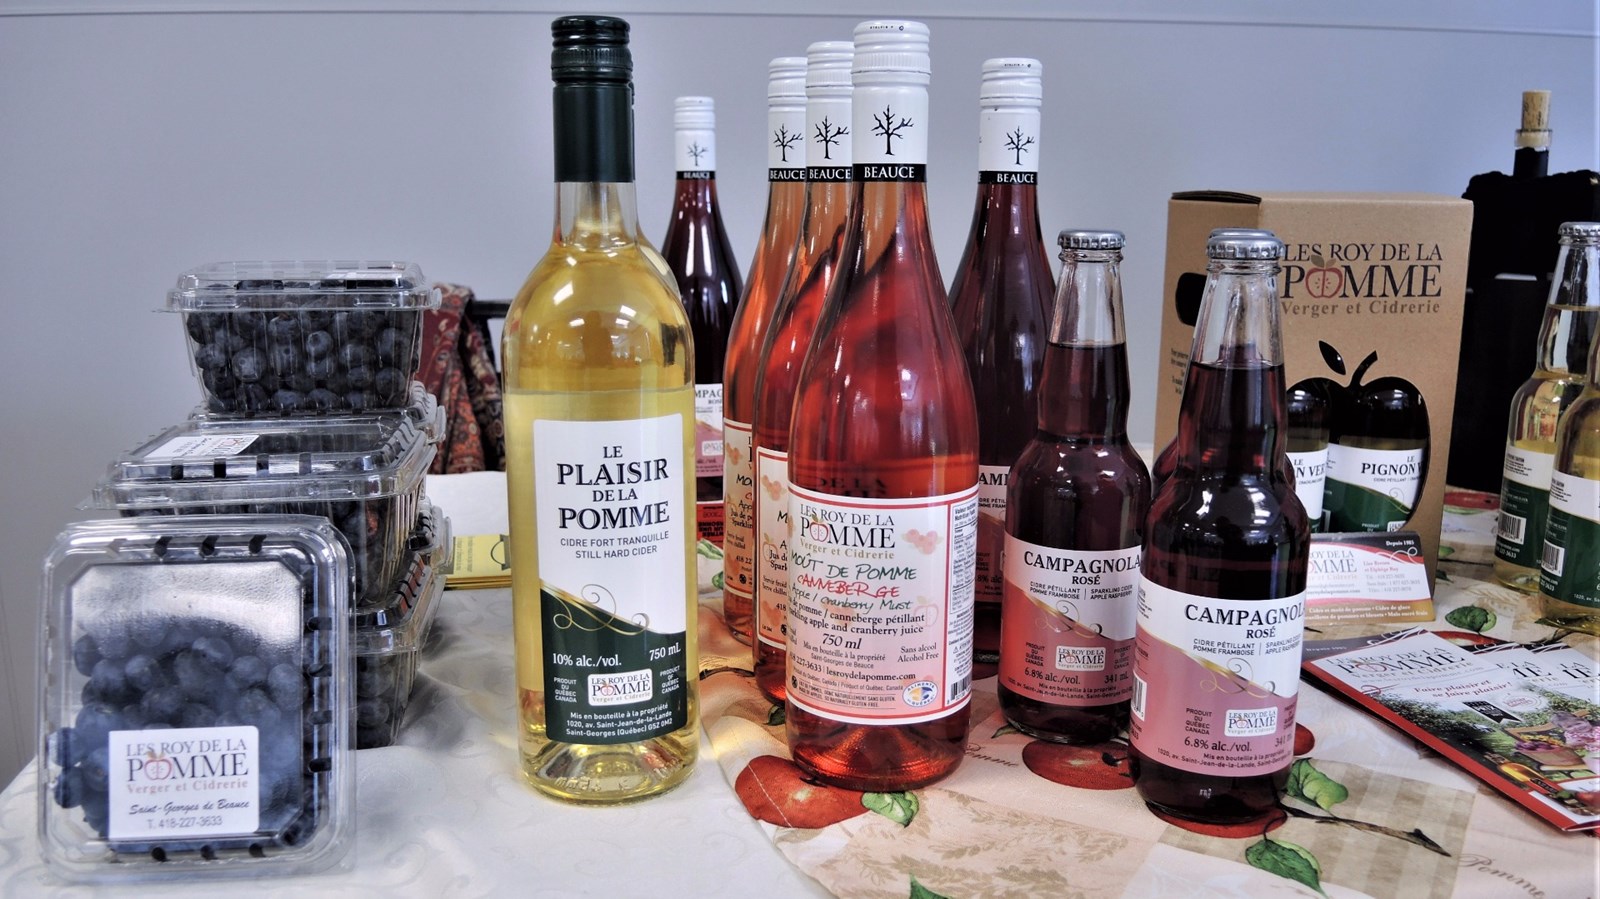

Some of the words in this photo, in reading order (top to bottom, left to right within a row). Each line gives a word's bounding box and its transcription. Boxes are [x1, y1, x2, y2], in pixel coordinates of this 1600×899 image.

[770, 170, 805, 179] BEAUCE
[809, 169, 850, 179] BEAUCE
[864, 166, 915, 178] BEAUCE
[997, 174, 1034, 183] BEAUCE
[1283, 243, 1322, 262] LES
[1330, 244, 1373, 262] ROY
[1380, 244, 1410, 261] DE
[1416, 243, 1443, 260] LA
[1280, 264, 1441, 299] POMME
[1281, 302, 1339, 317] Verger
[1347, 304, 1362, 314] et
[1369, 300, 1440, 314] Cidrerie
[603, 446, 623, 458] LE
[557, 458, 668, 485] PLAISIR
[1361, 462, 1416, 475] PIGNON
[592, 490, 614, 502] DE
[618, 488, 638, 500] LA
[559, 501, 669, 530] POMME
[801, 504, 818, 516] LES
[821, 510, 847, 523] ROY
[852, 514, 871, 525] DE
[876, 515, 894, 526] LA
[560, 538, 587, 547] CIDRE
[591, 538, 614, 547] FORT
[617, 531, 669, 545] TRANQUILLE
[801, 516, 895, 549] POMME
[604, 547, 629, 558] HARD
[632, 545, 657, 556] CIDER
[801, 538, 827, 556] Verger
[832, 546, 840, 555] et
[844, 549, 894, 559] Cidrerie
[792, 551, 823, 571] MOÛT
[826, 565, 849, 578] DE
[856, 563, 917, 580] POMME
[1024, 551, 1141, 574] CAMPAGNOLA
[1030, 581, 1046, 589] CIDRE
[1048, 584, 1080, 593] PÉTILLANT
[1072, 575, 1100, 585] ROSÉ
[792, 583, 810, 600] Apple
[820, 596, 873, 614] Cranberry
[880, 599, 911, 610] Must
[1030, 587, 1047, 596] POMME
[1049, 590, 1080, 599] FRAMBOISE
[800, 603, 822, 616] pomme
[830, 612, 882, 625] canneberge
[886, 614, 924, 625] pétillant
[1185, 603, 1305, 626] CAMPAGNOL
[810, 618, 828, 628] apple
[832, 623, 847, 632] and
[850, 625, 898, 636] cranberry
[900, 626, 923, 636] juice
[1246, 626, 1275, 639] ROSÉ
[823, 633, 842, 646] 750
[845, 638, 862, 649] ml
[918, 642, 936, 652] alcool
[1194, 639, 1215, 647] CIDRE
[1218, 641, 1255, 649] PÉTILLANT
[649, 648, 665, 661] 750
[668, 642, 681, 656] mL
[820, 646, 843, 657] bouteille
[856, 653, 885, 661] propriété
[897, 653, 924, 662] Alcohol
[926, 652, 939, 660] Free
[1218, 647, 1254, 656] FRAMBOISE
[553, 653, 573, 666] 10%
[576, 655, 622, 667] alc./vol.
[1058, 654, 1104, 664] POMME
[660, 665, 680, 676] PRODUCT
[796, 657, 821, 672] 227-3633
[826, 667, 916, 682] lesroydelapomme.com
[1024, 668, 1044, 680] 6.8%
[1045, 673, 1080, 684] alc./vol.
[555, 689, 576, 697] QUÉBEC
[592, 680, 650, 696] POMME
[662, 684, 679, 694] CANADA
[1444, 690, 1471, 699] faire
[1473, 682, 1513, 696] plaisir!
[1445, 682, 1480, 692] plaisir
[594, 711, 624, 720] bouteille
[640, 703, 668, 716] propriété
[1186, 708, 1212, 717] PRODUIT
[567, 720, 583, 729] 1020,
[597, 711, 672, 728] Saint-Jean-de-la-Lande
[1186, 720, 1210, 729] QUÉBEC
[1229, 716, 1275, 728] POMME
[566, 729, 615, 738] Saint-Georges
[617, 725, 647, 736] (Québec)
[1185, 726, 1210, 735] CANADA
[127, 744, 155, 756] LES
[161, 741, 193, 754] ROY
[200, 740, 221, 752] DE
[227, 739, 247, 751] LA
[1184, 736, 1209, 749] 6.8%
[1211, 741, 1252, 752] alc./vol.
[127, 753, 248, 781] POMME
[127, 784, 170, 794] Verger
[193, 780, 248, 790] Cidrerie
[129, 802, 199, 815] Saint-Georges
[203, 801, 214, 809] de
[218, 799, 250, 809] Beauce
[158, 816, 222, 828] 418-227-3633
